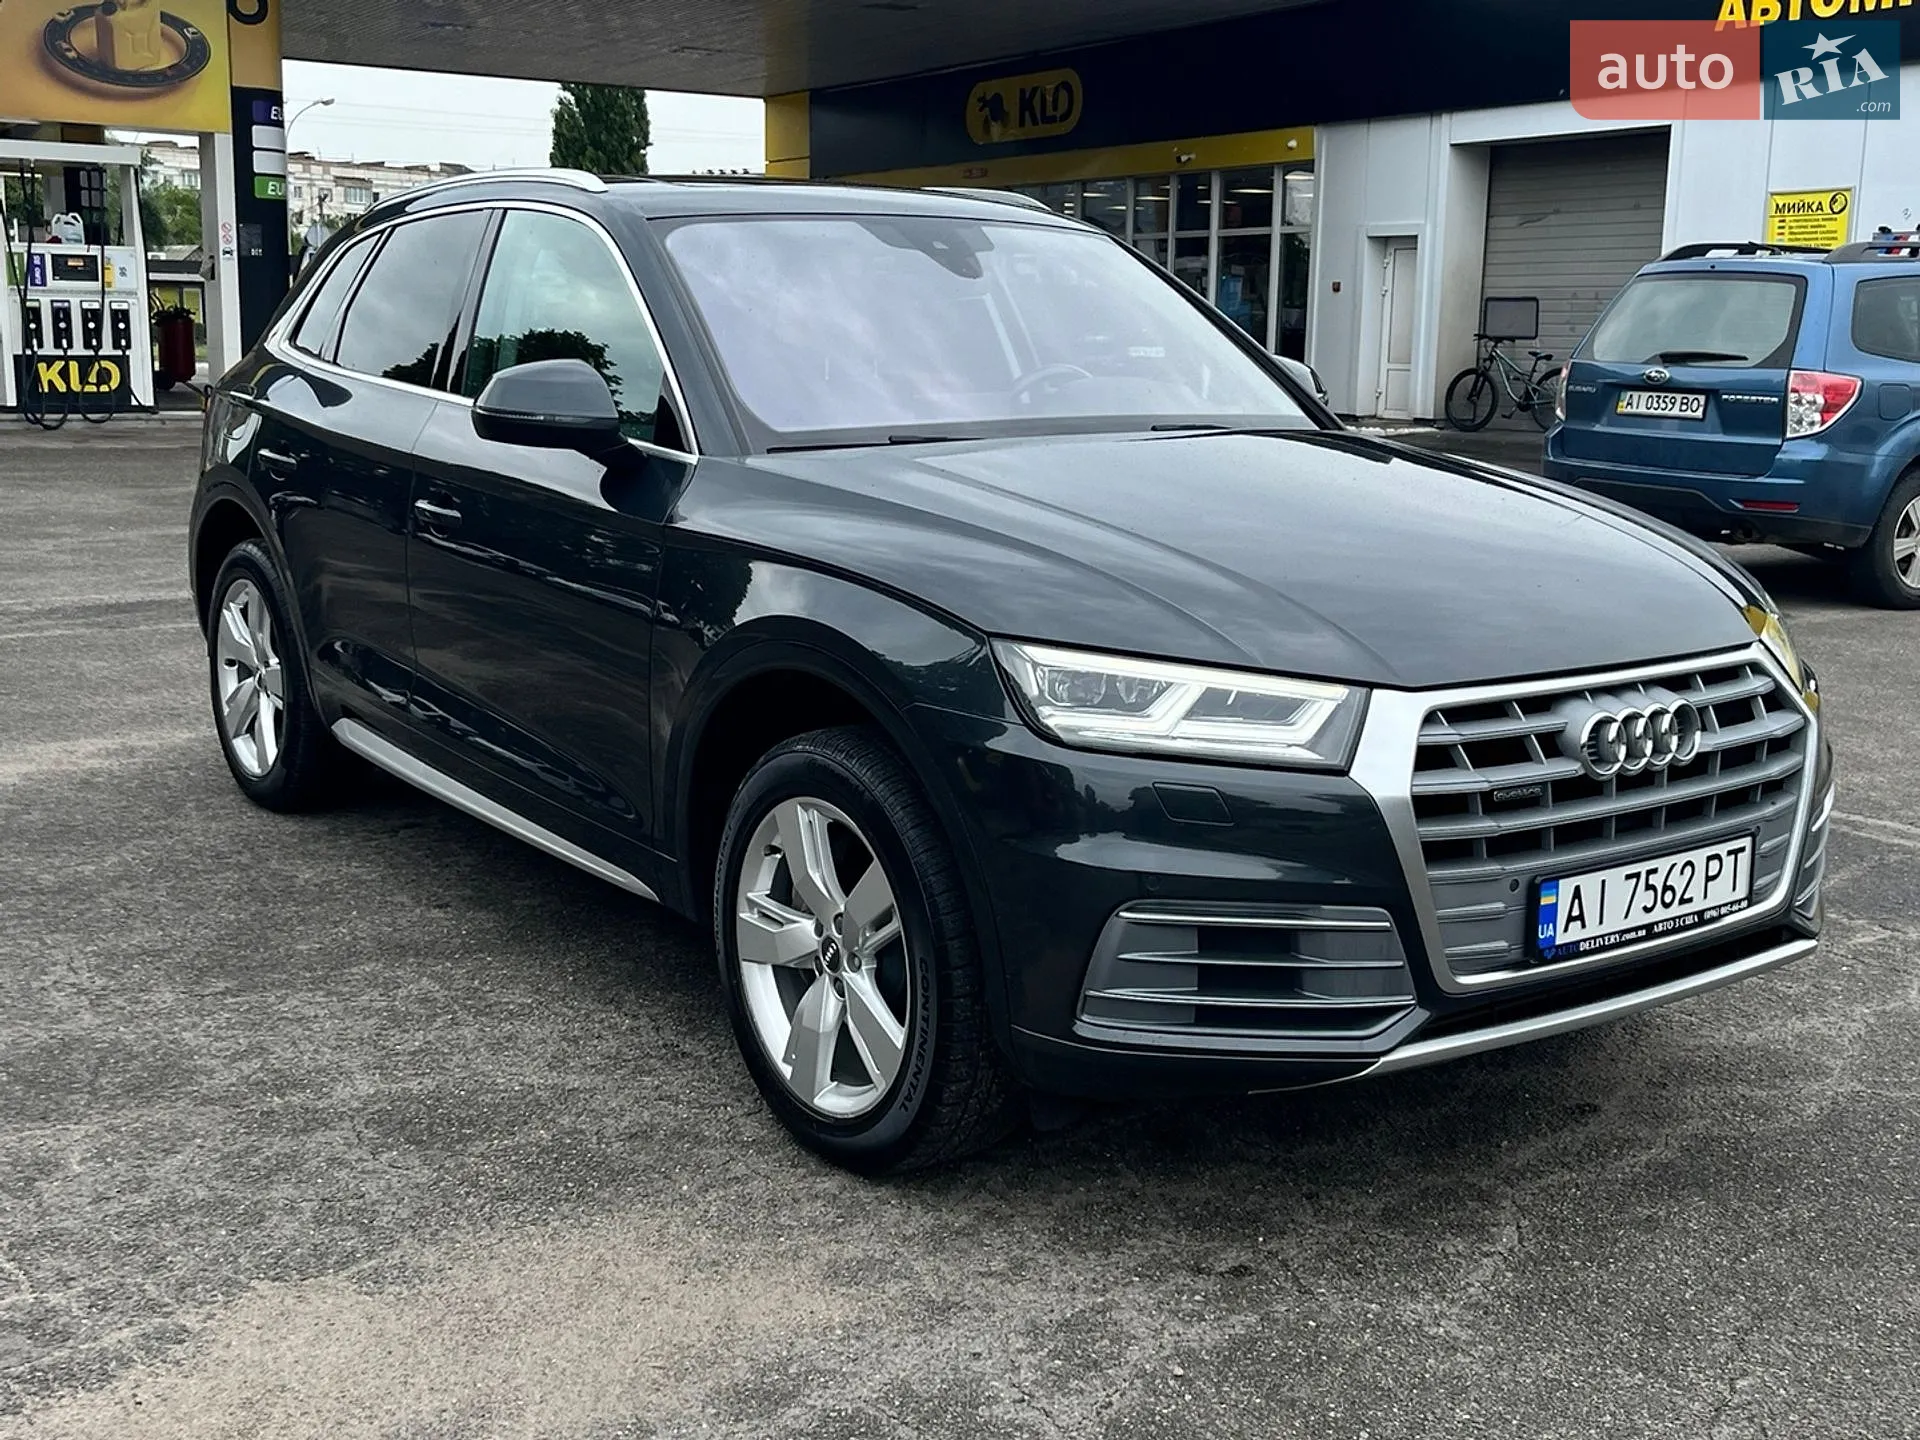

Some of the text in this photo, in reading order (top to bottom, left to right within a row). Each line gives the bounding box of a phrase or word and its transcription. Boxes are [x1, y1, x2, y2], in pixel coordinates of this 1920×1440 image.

[1018, 80, 1074, 128] KLO
[1774, 199, 1824, 214] МИЙКА
[37, 360, 121, 393] KLO
[1626, 393, 1700, 413] AI 0359 BO
[1563, 846, 1747, 933] AI 7562 PT
[1538, 924, 1555, 939] UA
[899, 956, 931, 1113] CONTINENTAL
